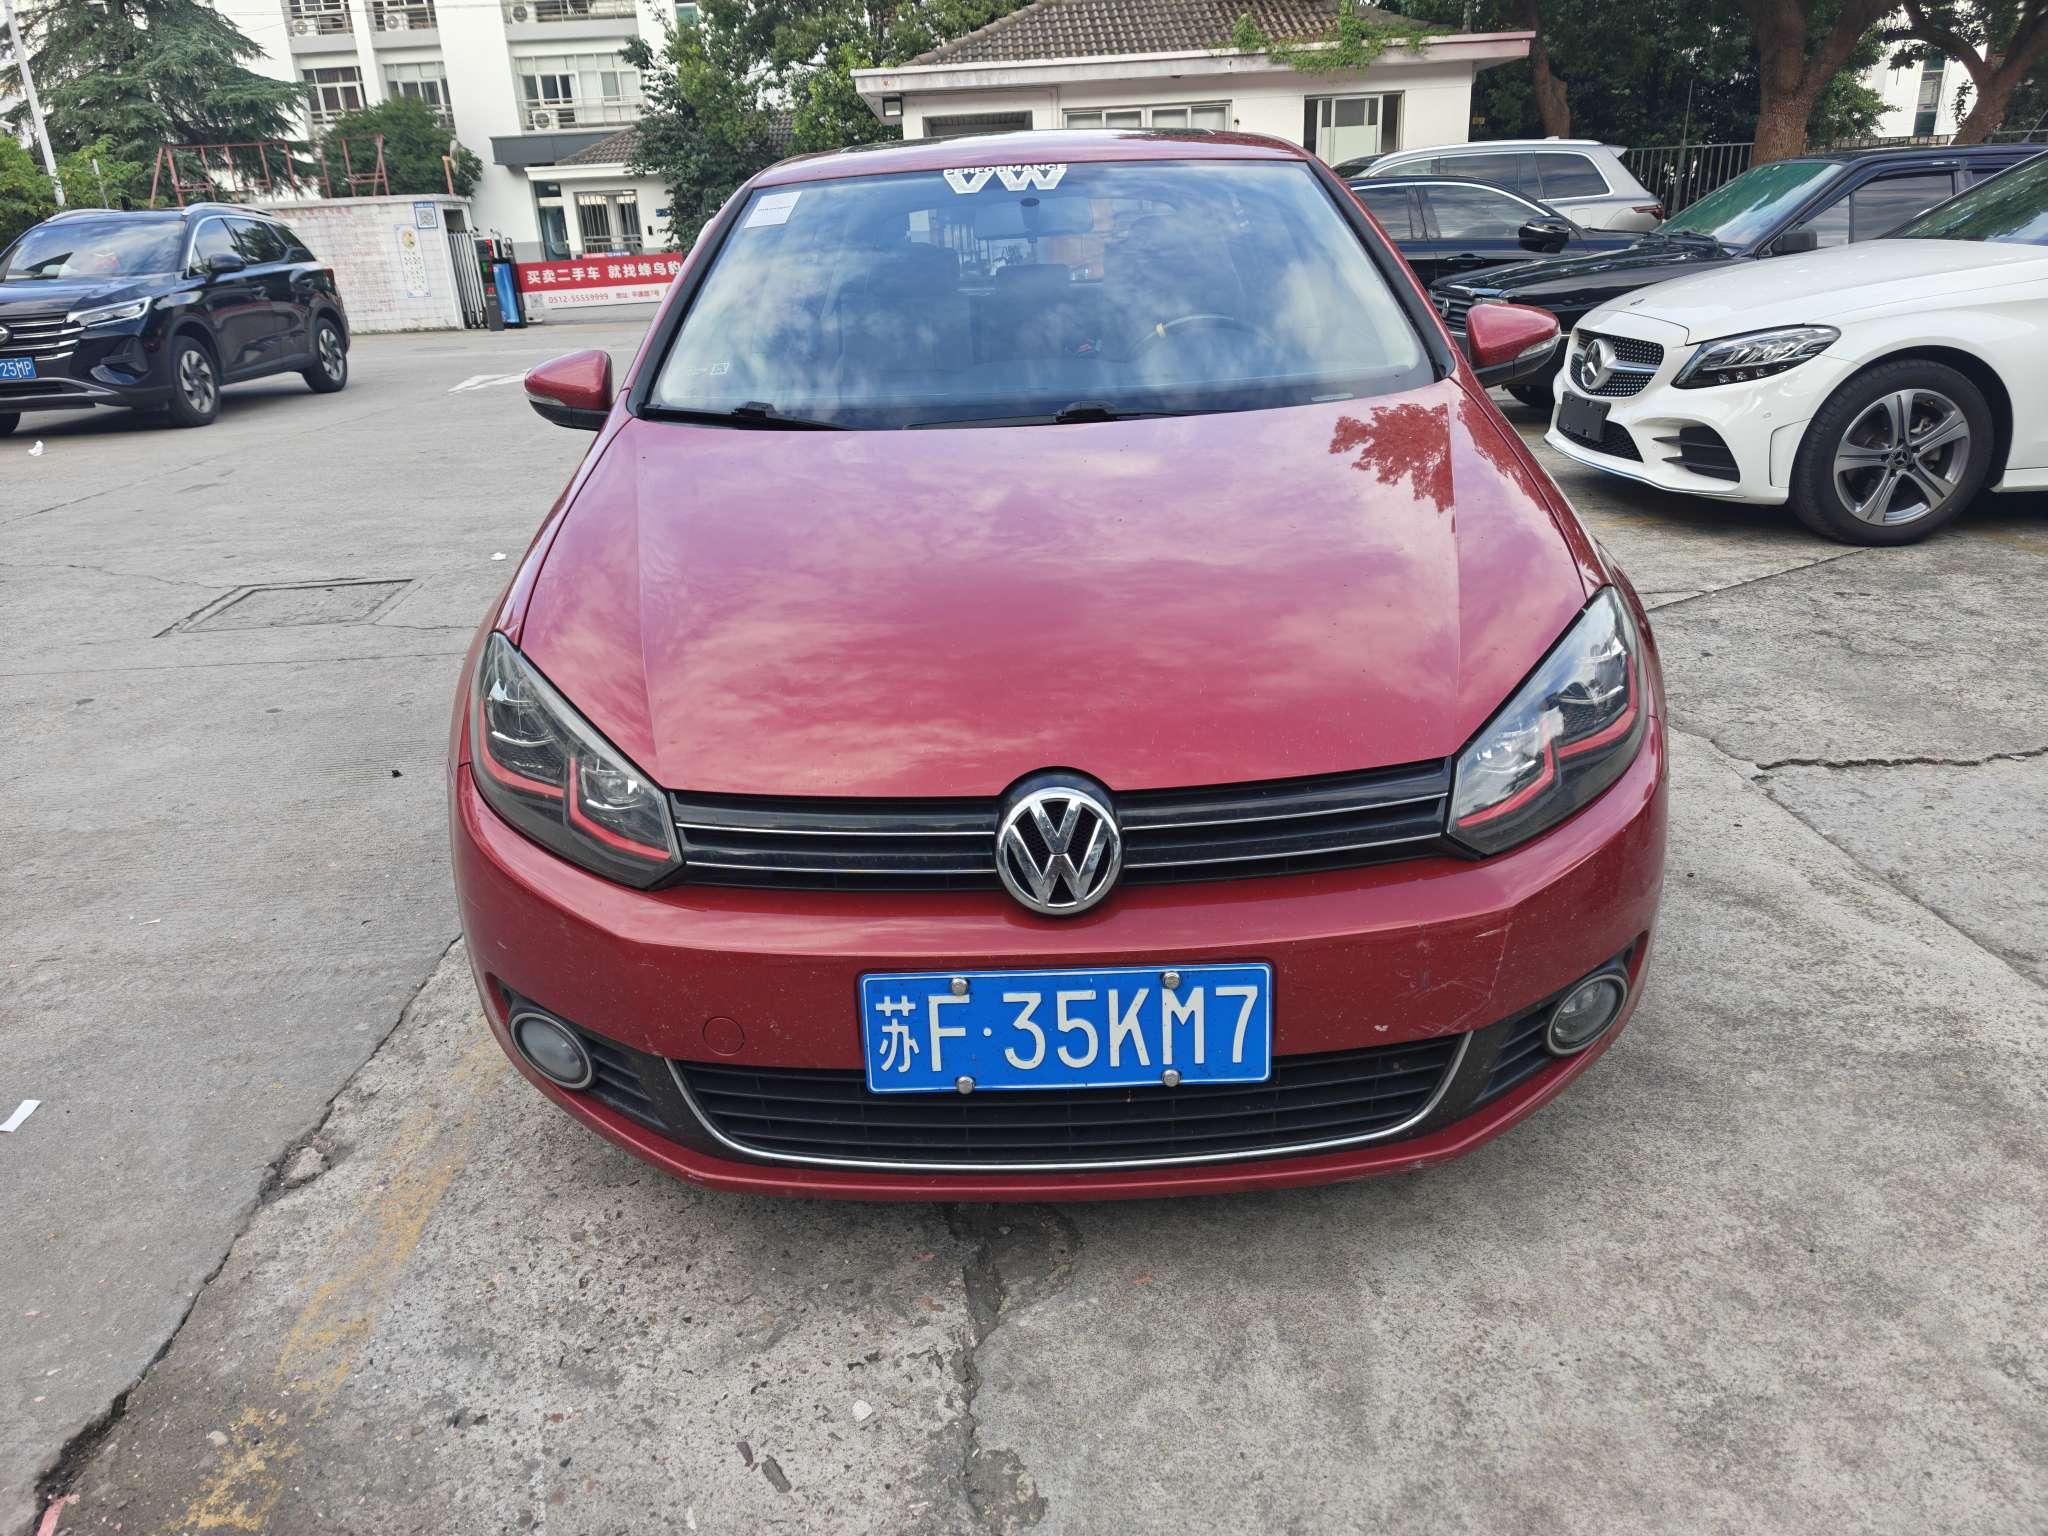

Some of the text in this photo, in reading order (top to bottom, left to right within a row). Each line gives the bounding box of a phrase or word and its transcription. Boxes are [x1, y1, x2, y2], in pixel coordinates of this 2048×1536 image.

[944, 163, 1067, 176] PERFORMANCE
[526, 266, 600, 285] 买卖二手车
[1004, 795, 1118, 908] VW
[875, 985, 1259, 1073] 苏F·35KM7
